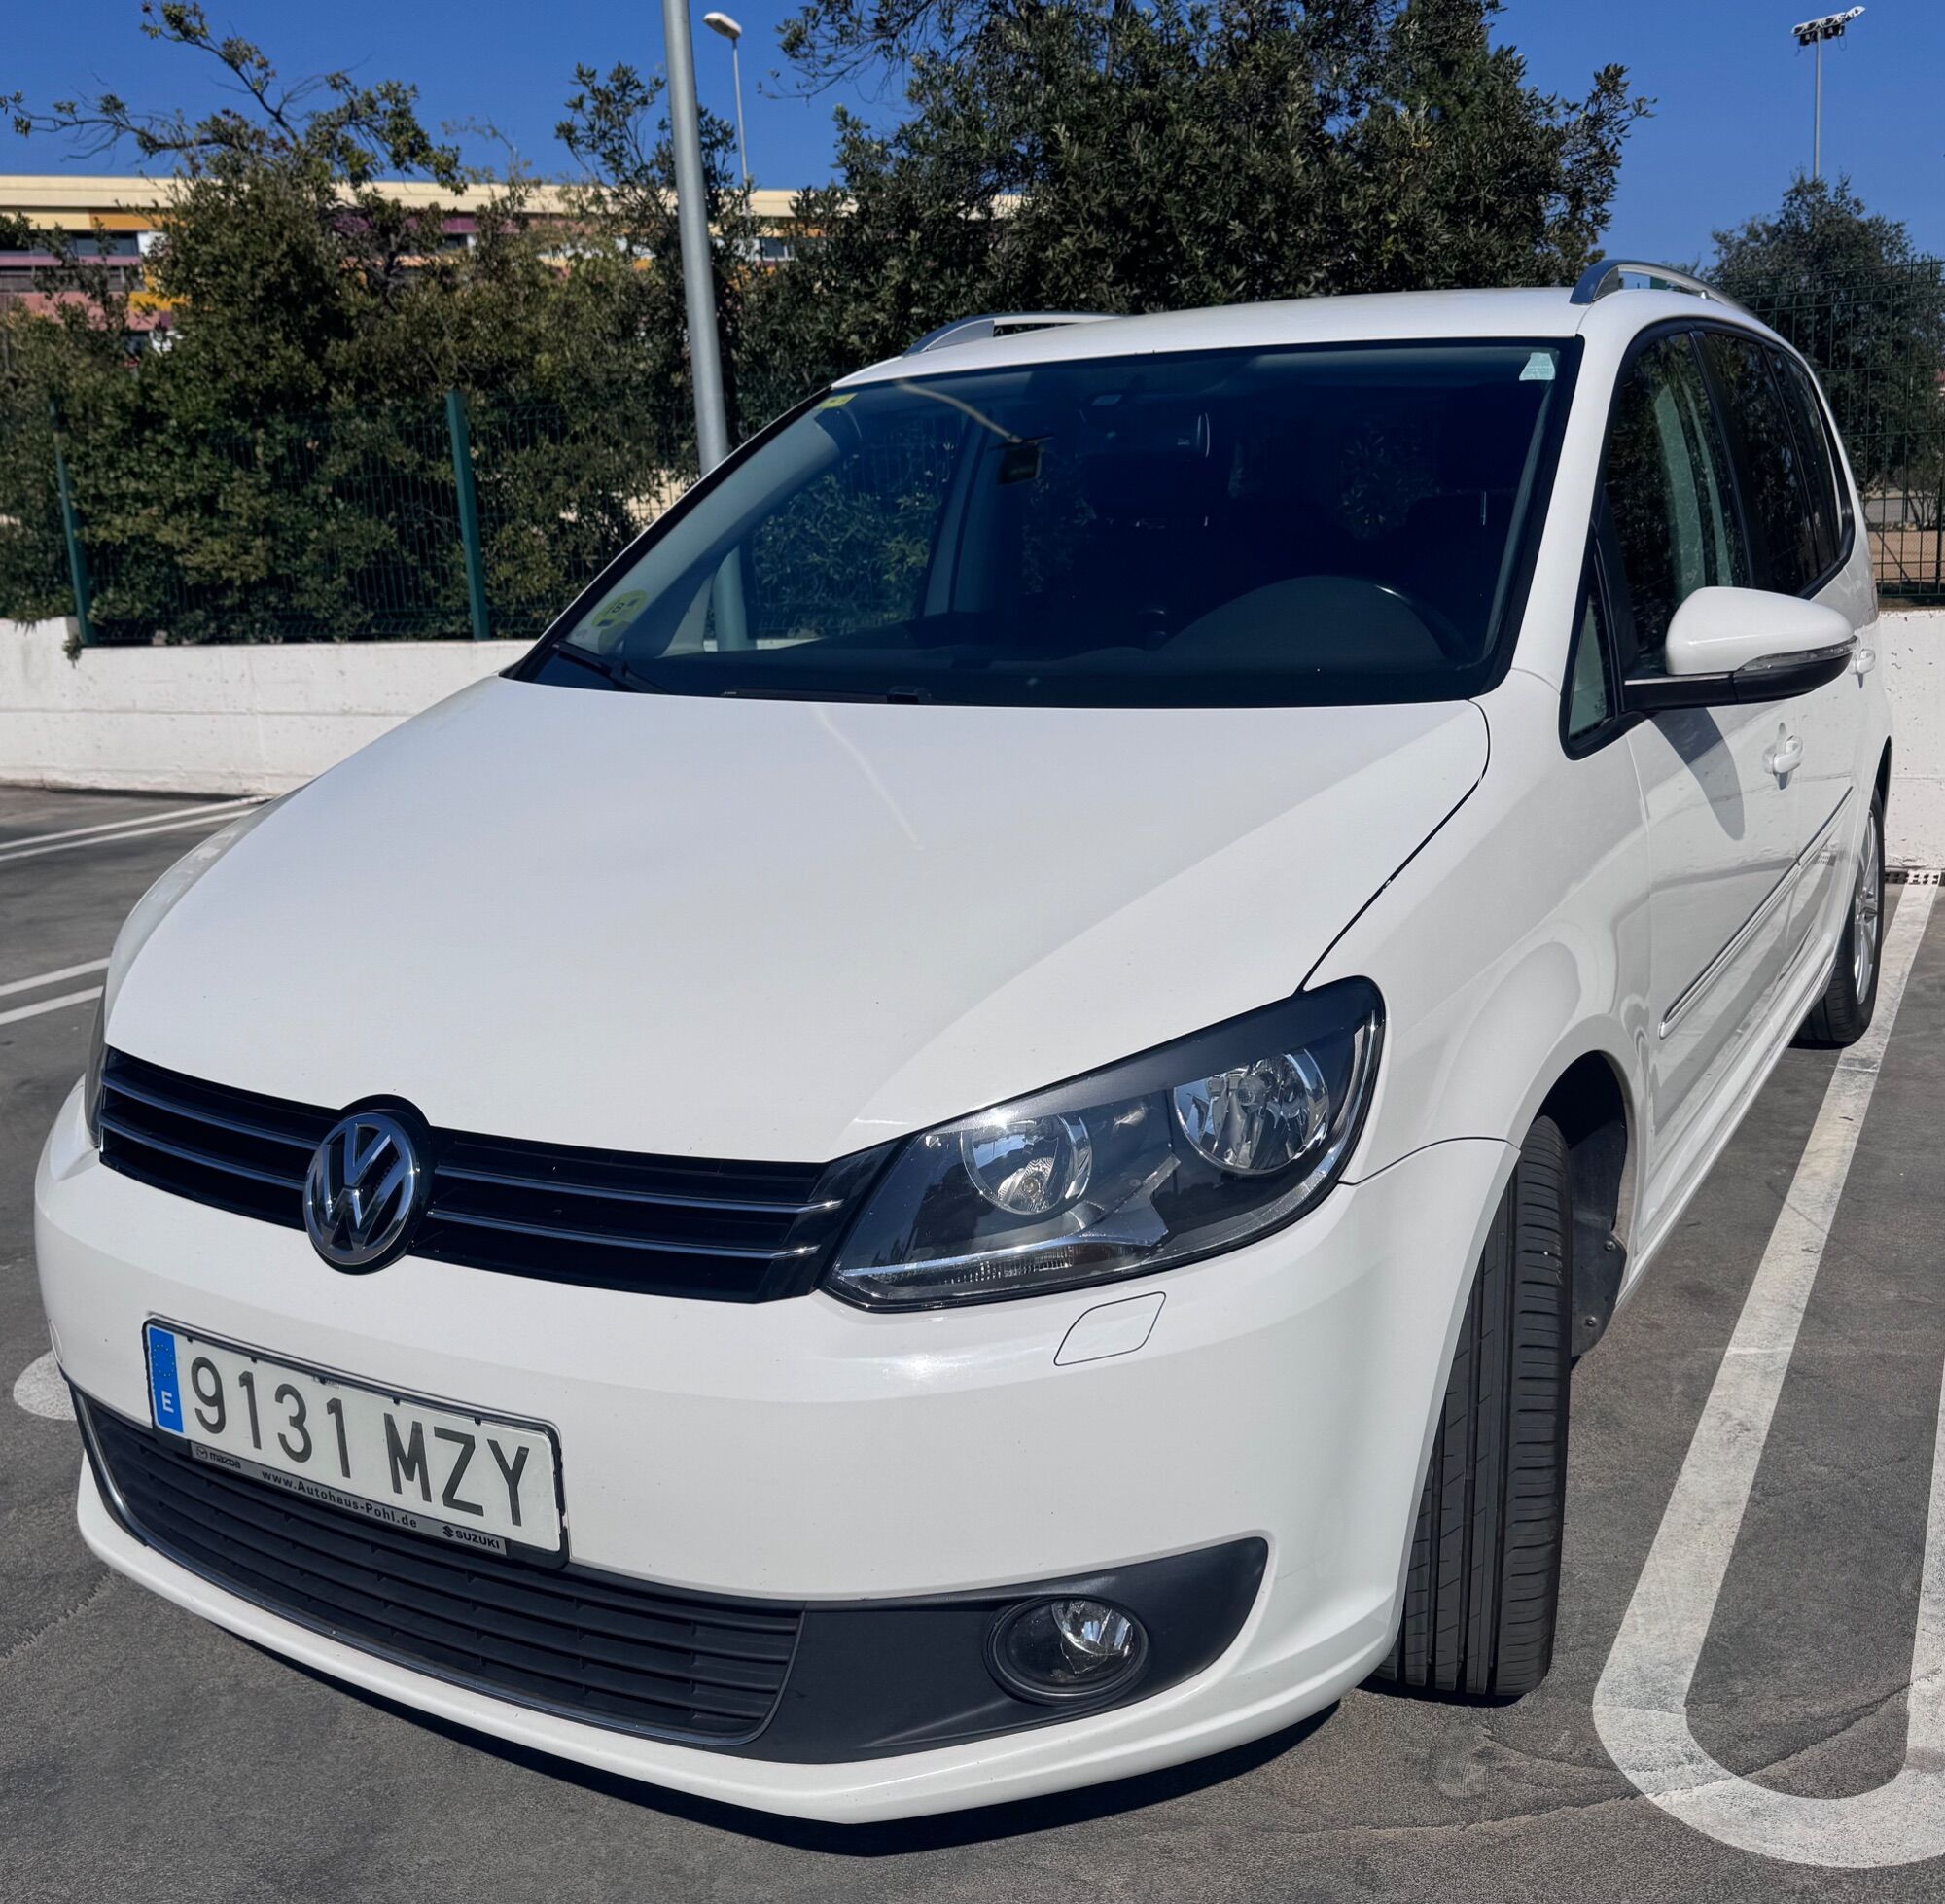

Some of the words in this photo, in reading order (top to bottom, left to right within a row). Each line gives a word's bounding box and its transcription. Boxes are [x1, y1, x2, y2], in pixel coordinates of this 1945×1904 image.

[162, 1391, 174, 1414] E
[191, 1357, 351, 1478] 9131
[383, 1412, 530, 1527] MZY
[262, 1470, 417, 1528] www.Autohaus-Pohl.de
[456, 1530, 500, 1549] SUZUKI
